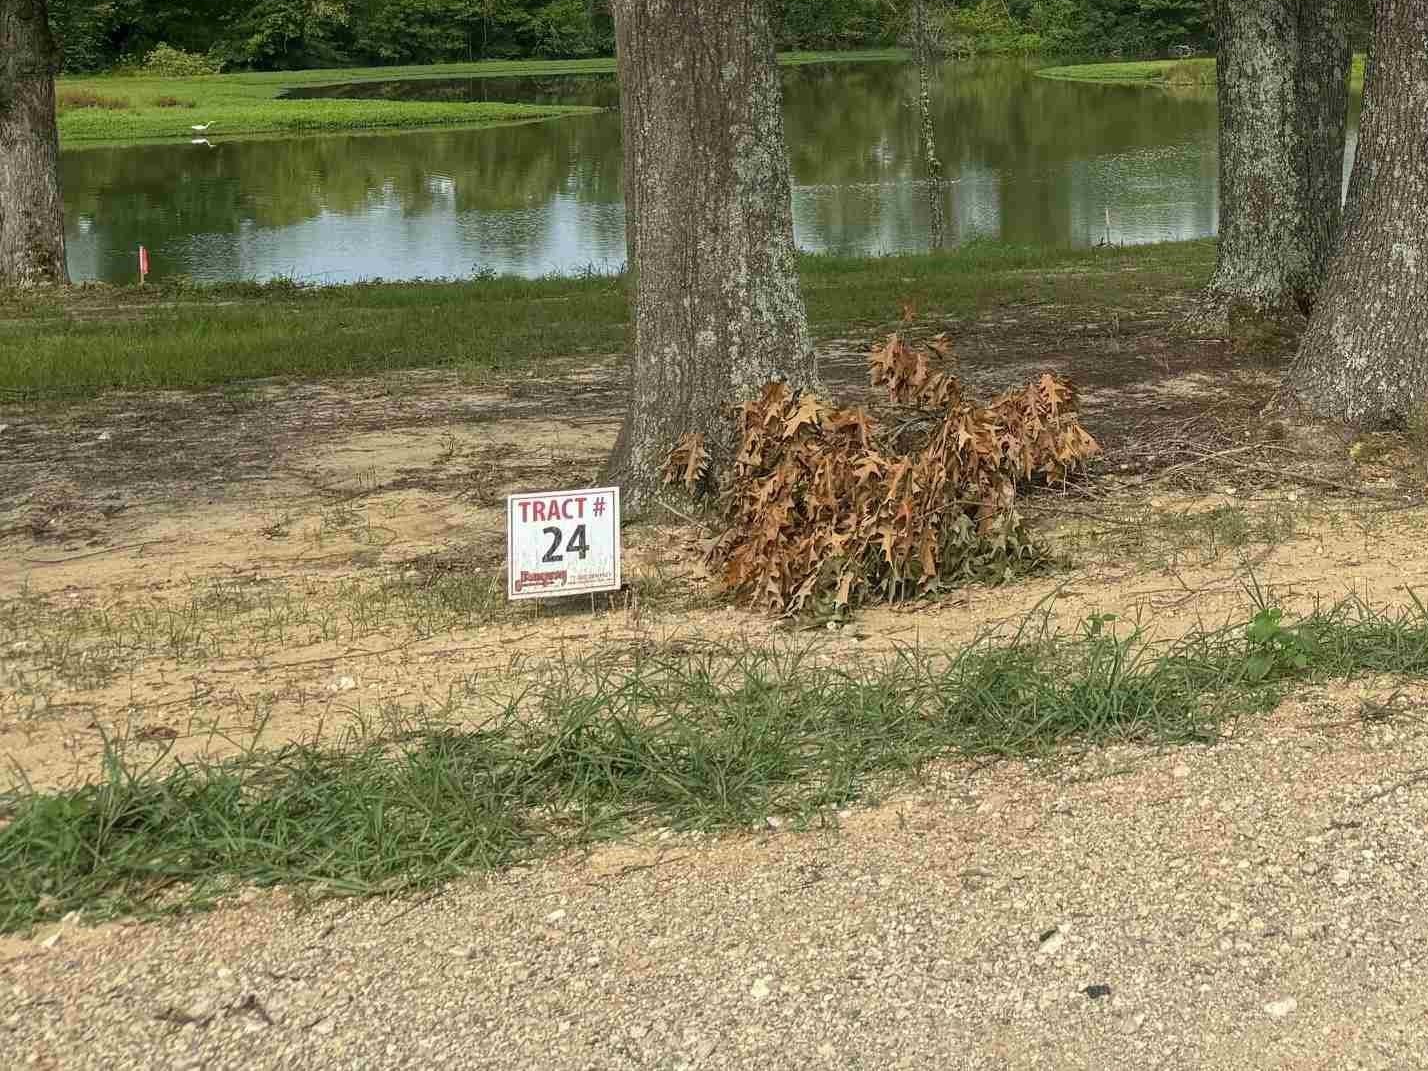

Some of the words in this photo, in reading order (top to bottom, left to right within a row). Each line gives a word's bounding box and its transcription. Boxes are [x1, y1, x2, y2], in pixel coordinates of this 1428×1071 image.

[518, 497, 588, 523] TRACT
[592, 496, 607, 517] #
[541, 524, 590, 563] 24
